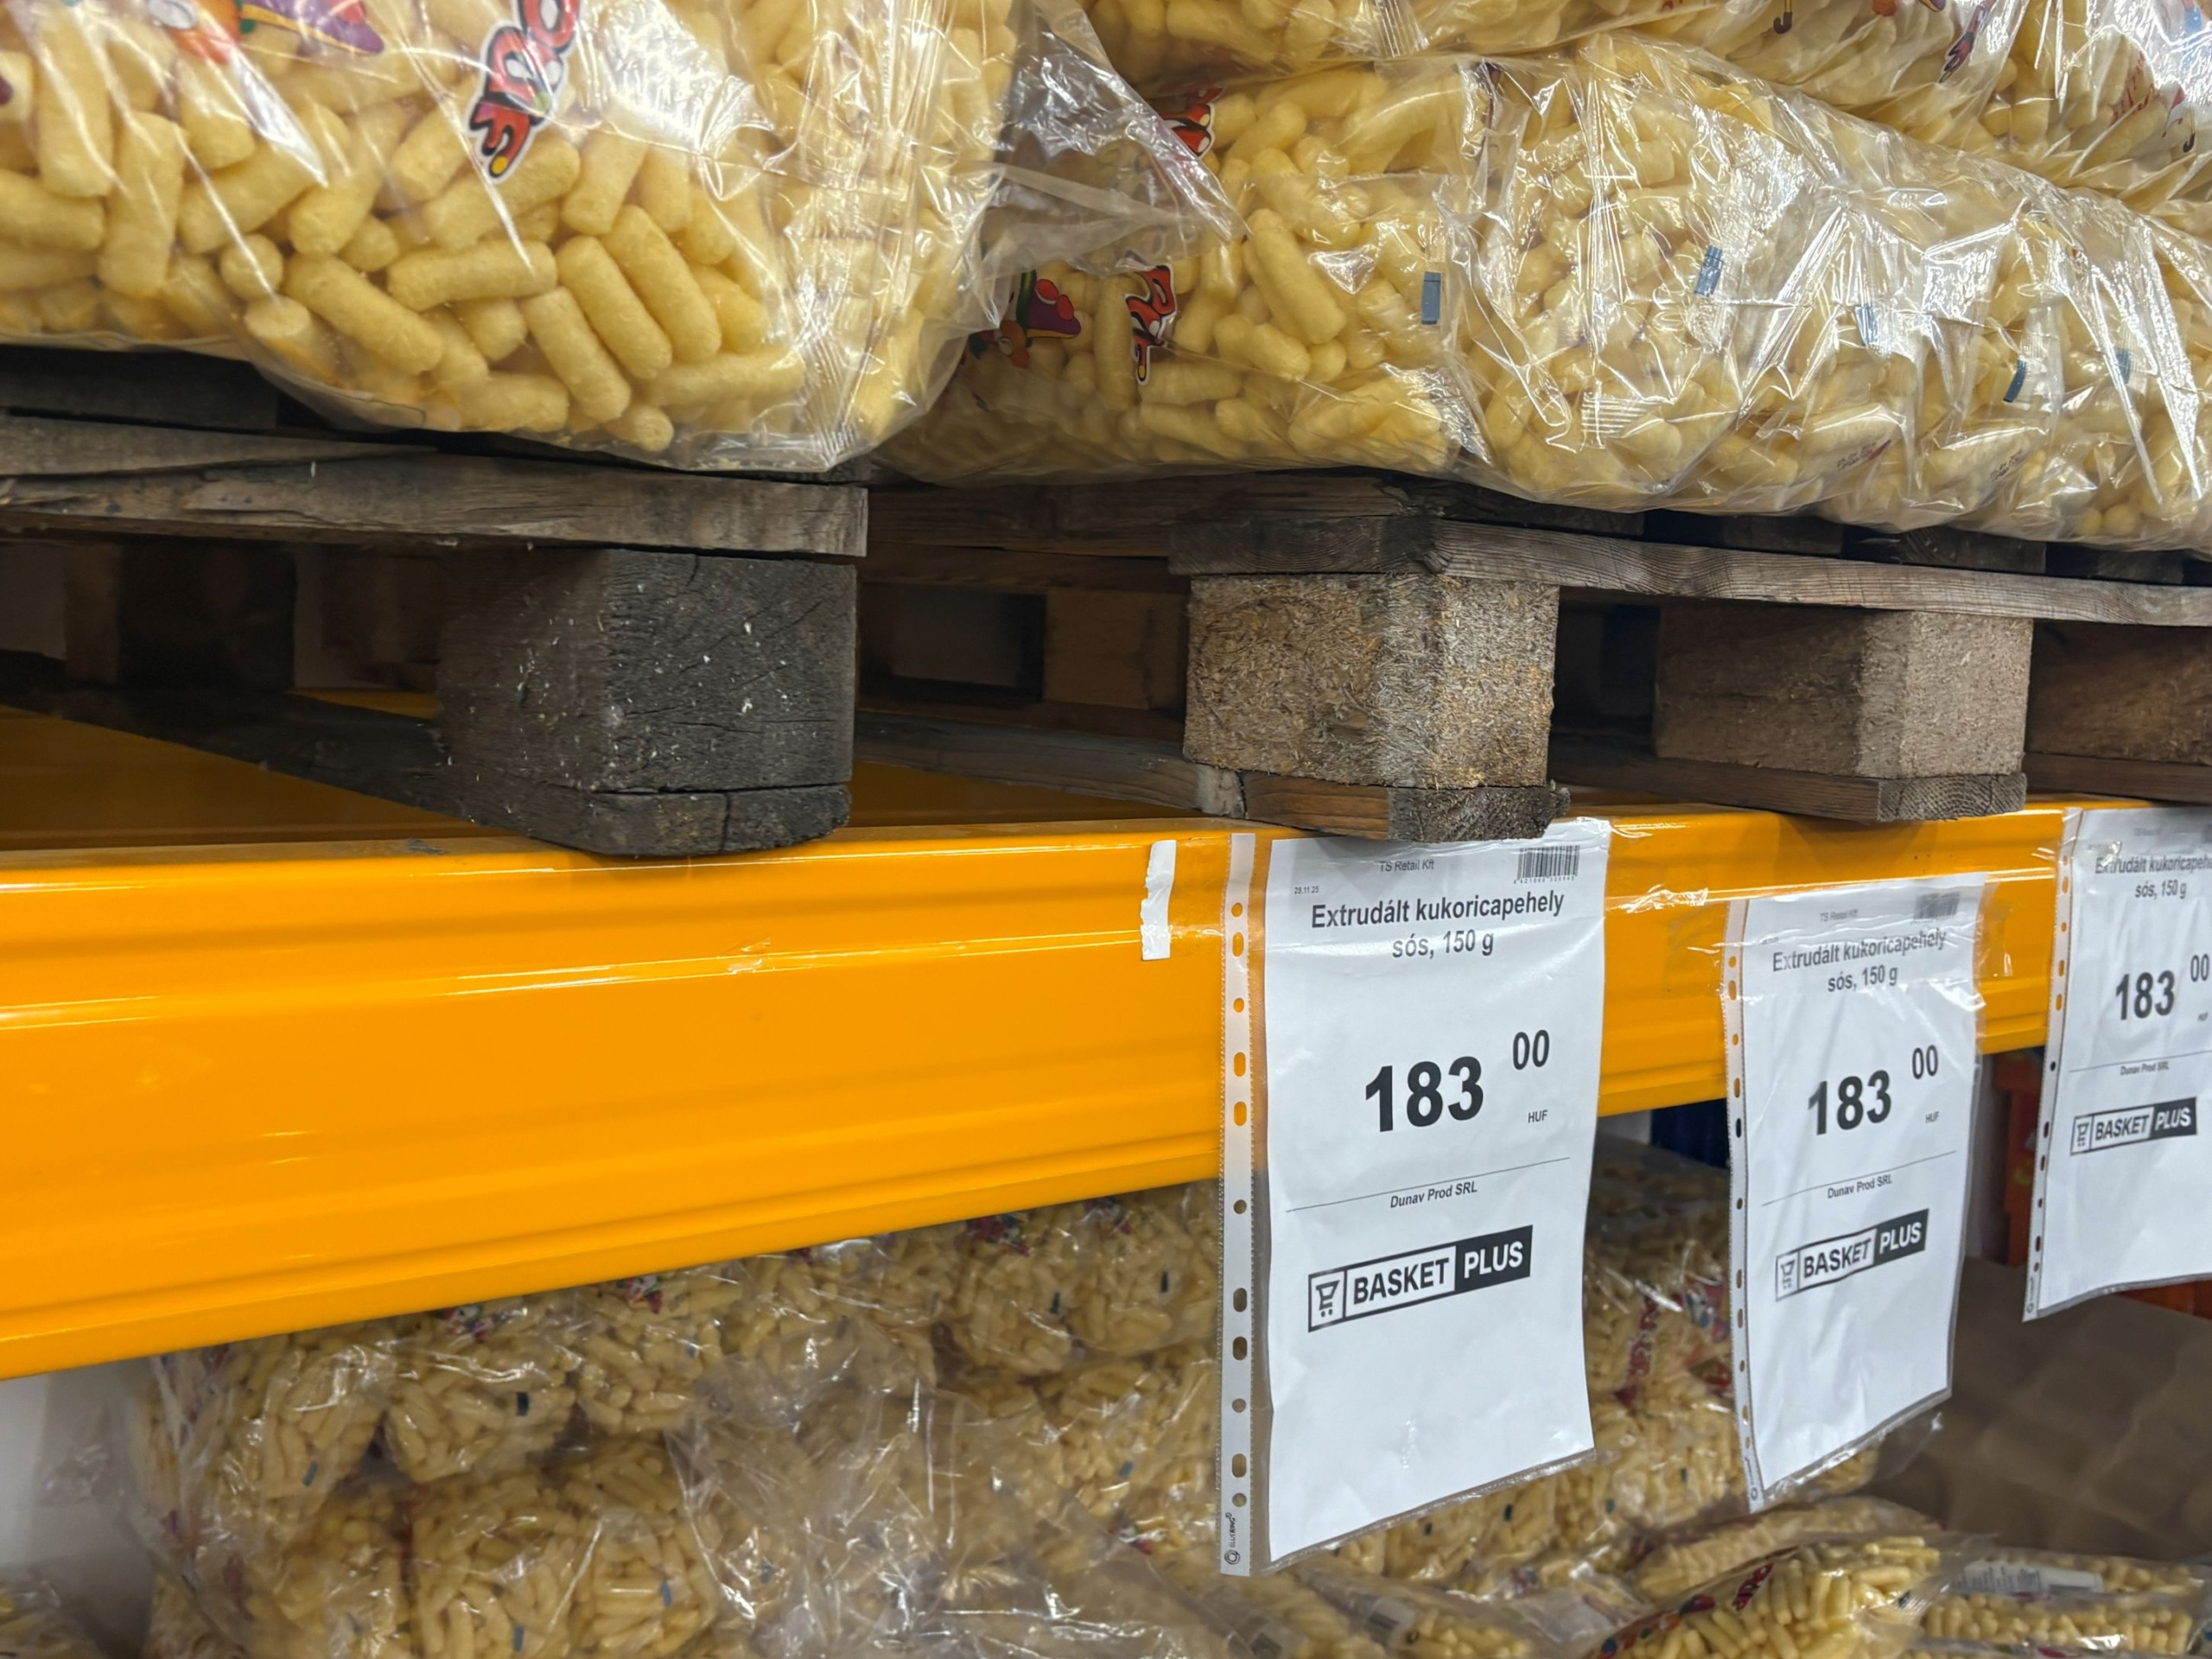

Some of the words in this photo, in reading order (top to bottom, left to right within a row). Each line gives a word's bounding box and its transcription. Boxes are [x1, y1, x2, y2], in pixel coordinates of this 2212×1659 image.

[1380, 861, 1392, 872] TS
[1394, 859, 1420, 872] Retail
[1421, 858, 1434, 870] Kft
[2135, 880, 2158, 899] sós,
[2161, 879, 2178, 897] 150
[2179, 882, 2187, 899] g
[1312, 899, 1409, 928] Extrudált
[1415, 890, 1564, 921] kukoricapehely
[1392, 933, 1434, 959] sós,
[1443, 929, 1476, 954] 150
[1482, 931, 1494, 956] g
[1773, 944, 1840, 971] Extrudált
[1844, 927, 1947, 957] kukoricapehely
[1827, 971, 1857, 992] sós,
[1862, 964, 1885, 986] 150
[1889, 966, 1898, 986] g
[2115, 969, 2175, 1020] 183
[2190, 953, 2210, 982] 00
[1365, 1056, 1484, 1133] 183
[1512, 1029, 1549, 1071] 00
[1808, 1070, 1891, 1135] 183
[1912, 1045, 1938, 1080] 00
[1528, 1109, 1548, 1123] HUF
[1925, 1111, 1940, 1123] HUF
[2094, 1115, 2150, 1141] BASKET
[2155, 1107, 2191, 1130] PLUS
[1390, 1192, 1425, 1208] Dunav
[1427, 1185, 1452, 1201] Prod
[1455, 1180, 1478, 1196] SRL
[1827, 1185, 1854, 1198] Dunav
[1857, 1179, 1875, 1193] Prod
[1877, 1174, 1892, 1186] SRL
[1803, 1238, 1872, 1279] BASKET
[1879, 1222, 1923, 1254] PLUS
[1353, 1257, 1450, 1305] BASKET
[1464, 1241, 1523, 1279] PLUS
